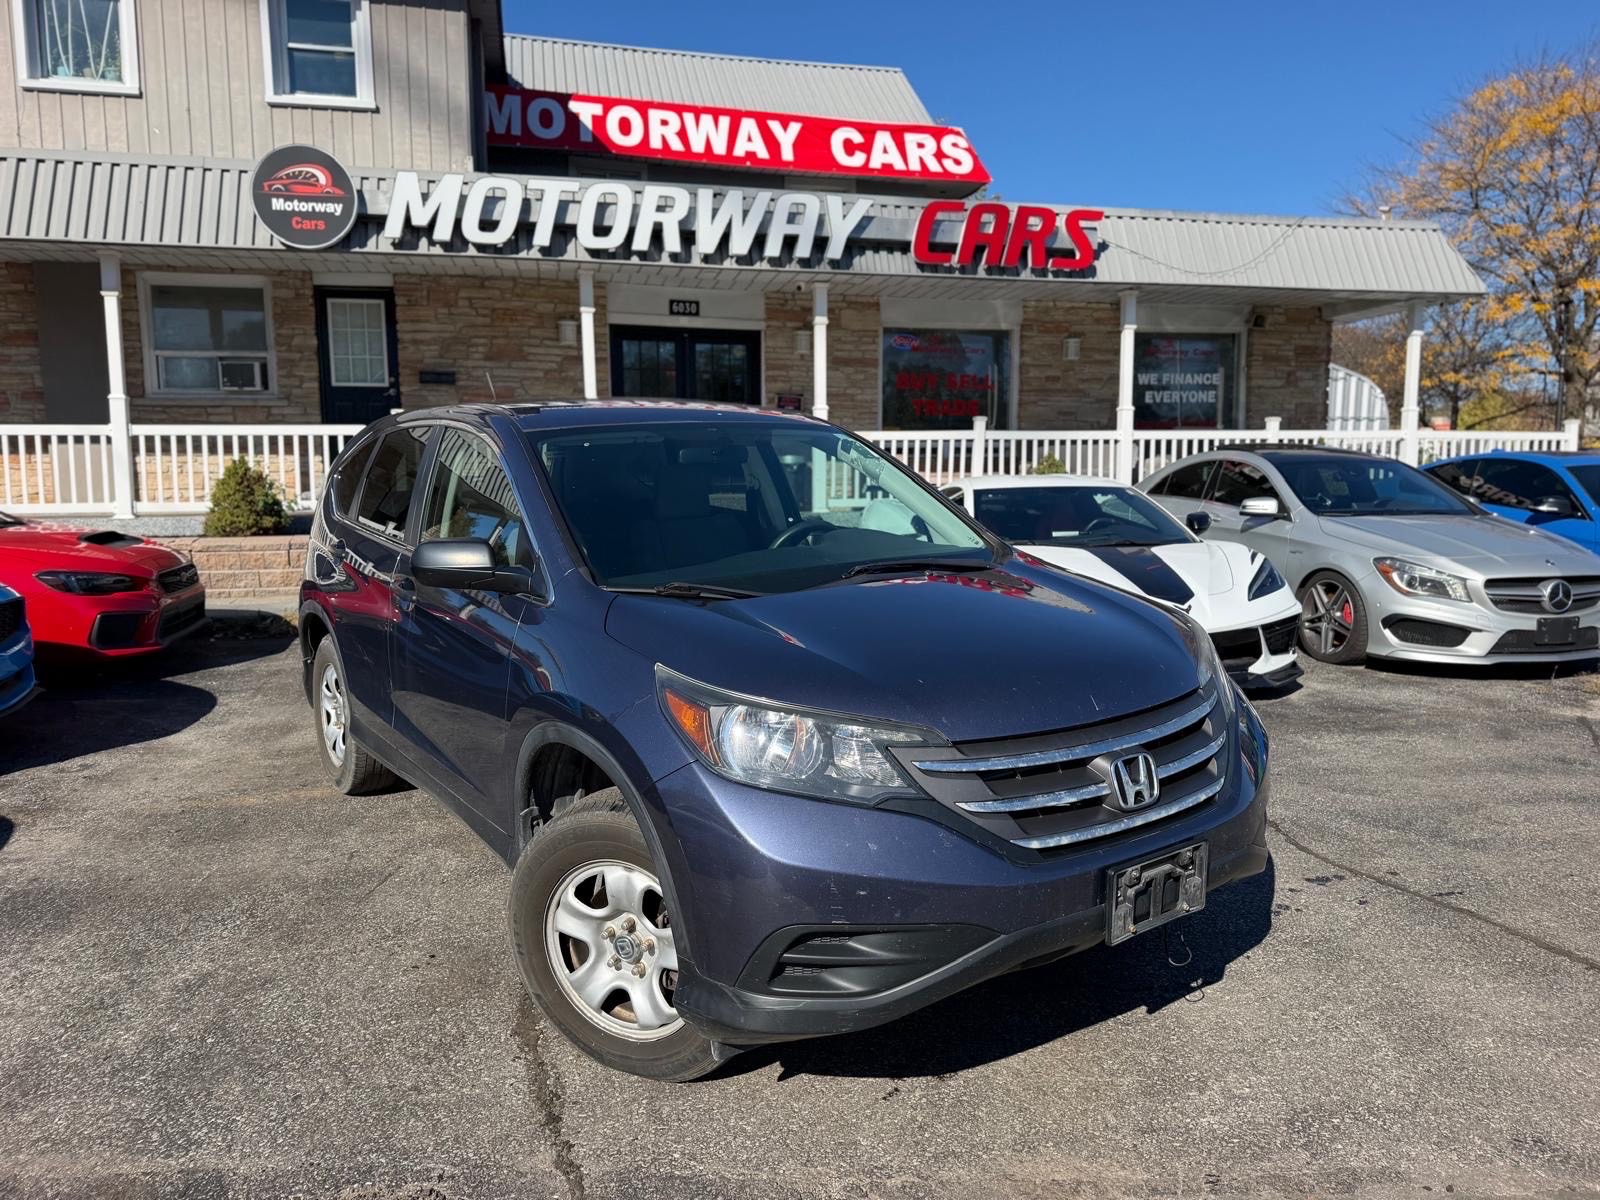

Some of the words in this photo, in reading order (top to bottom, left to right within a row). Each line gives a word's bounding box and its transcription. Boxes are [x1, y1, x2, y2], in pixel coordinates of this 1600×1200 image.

[485, 91, 802, 162] MOTORWAY
[830, 128, 974, 175] CARS
[271, 197, 343, 216] Motorway
[291, 215, 326, 231] Cars
[384, 171, 873, 260] MOTORWAY
[912, 200, 1104, 270] CARS
[672, 302, 697, 314] 6030
[896, 371, 938, 390] BUY
[945, 373, 994, 392] SELL
[1138, 373, 1158, 385] WE
[1162, 373, 1220, 385] FINANCE
[1144, 390, 1217, 403] EVERYONE
[911, 399, 980, 417] TRADE
